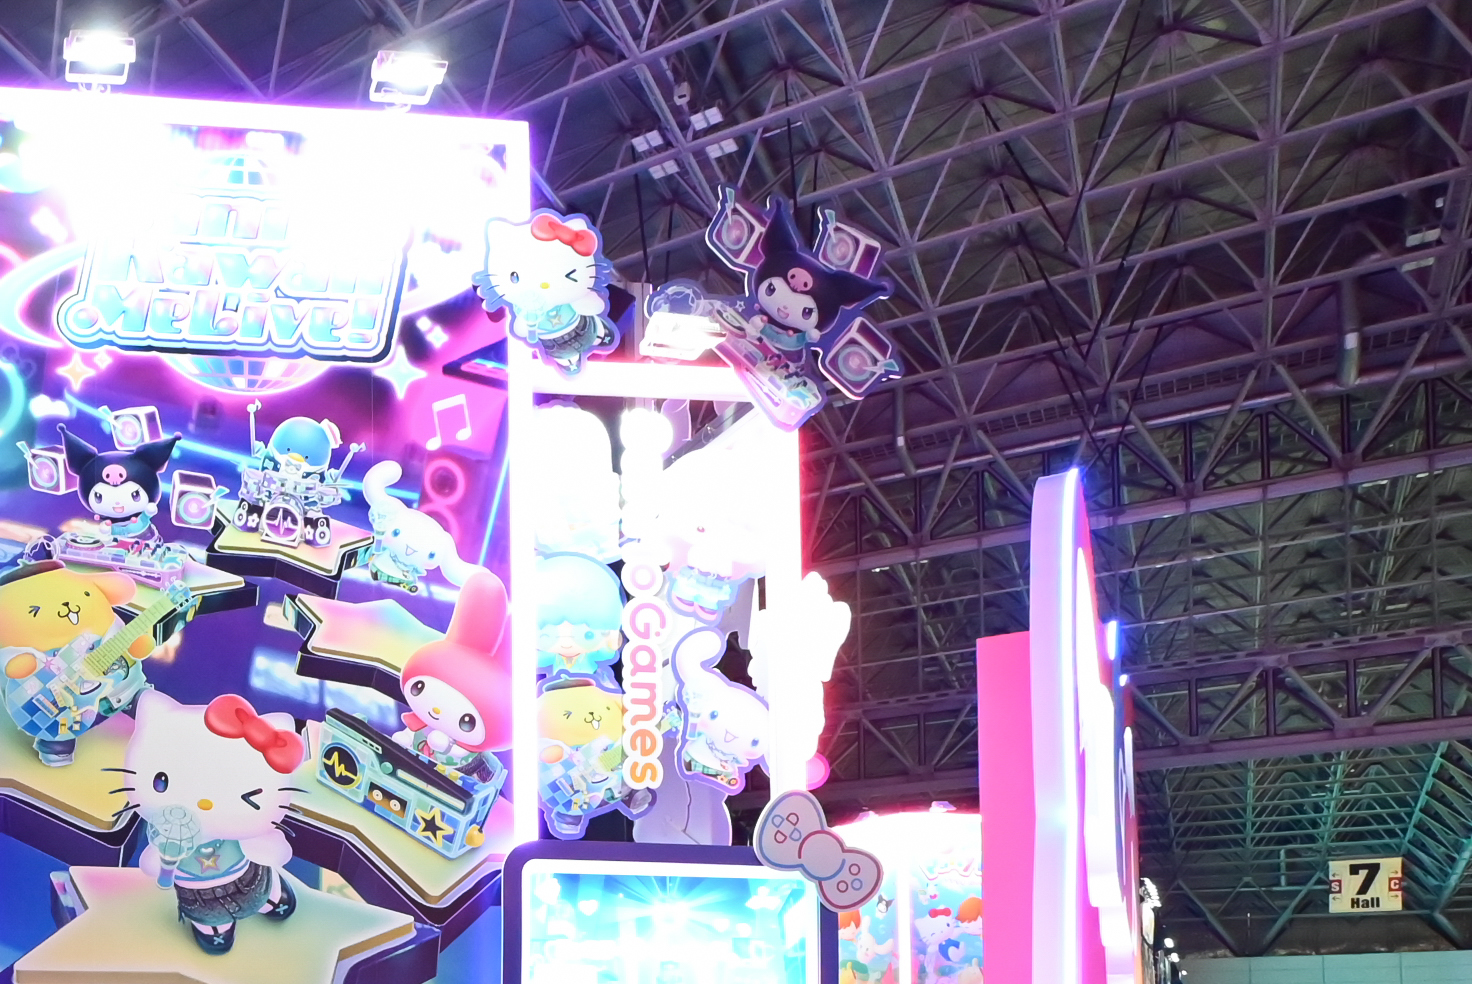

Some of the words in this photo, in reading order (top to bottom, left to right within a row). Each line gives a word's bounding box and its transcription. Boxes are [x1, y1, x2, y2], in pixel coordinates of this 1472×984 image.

[1349, 862, 1381, 896] 7
[1390, 879, 1400, 890] C
[1331, 881, 1340, 892] S
[1350, 896, 1381, 909] Hall
